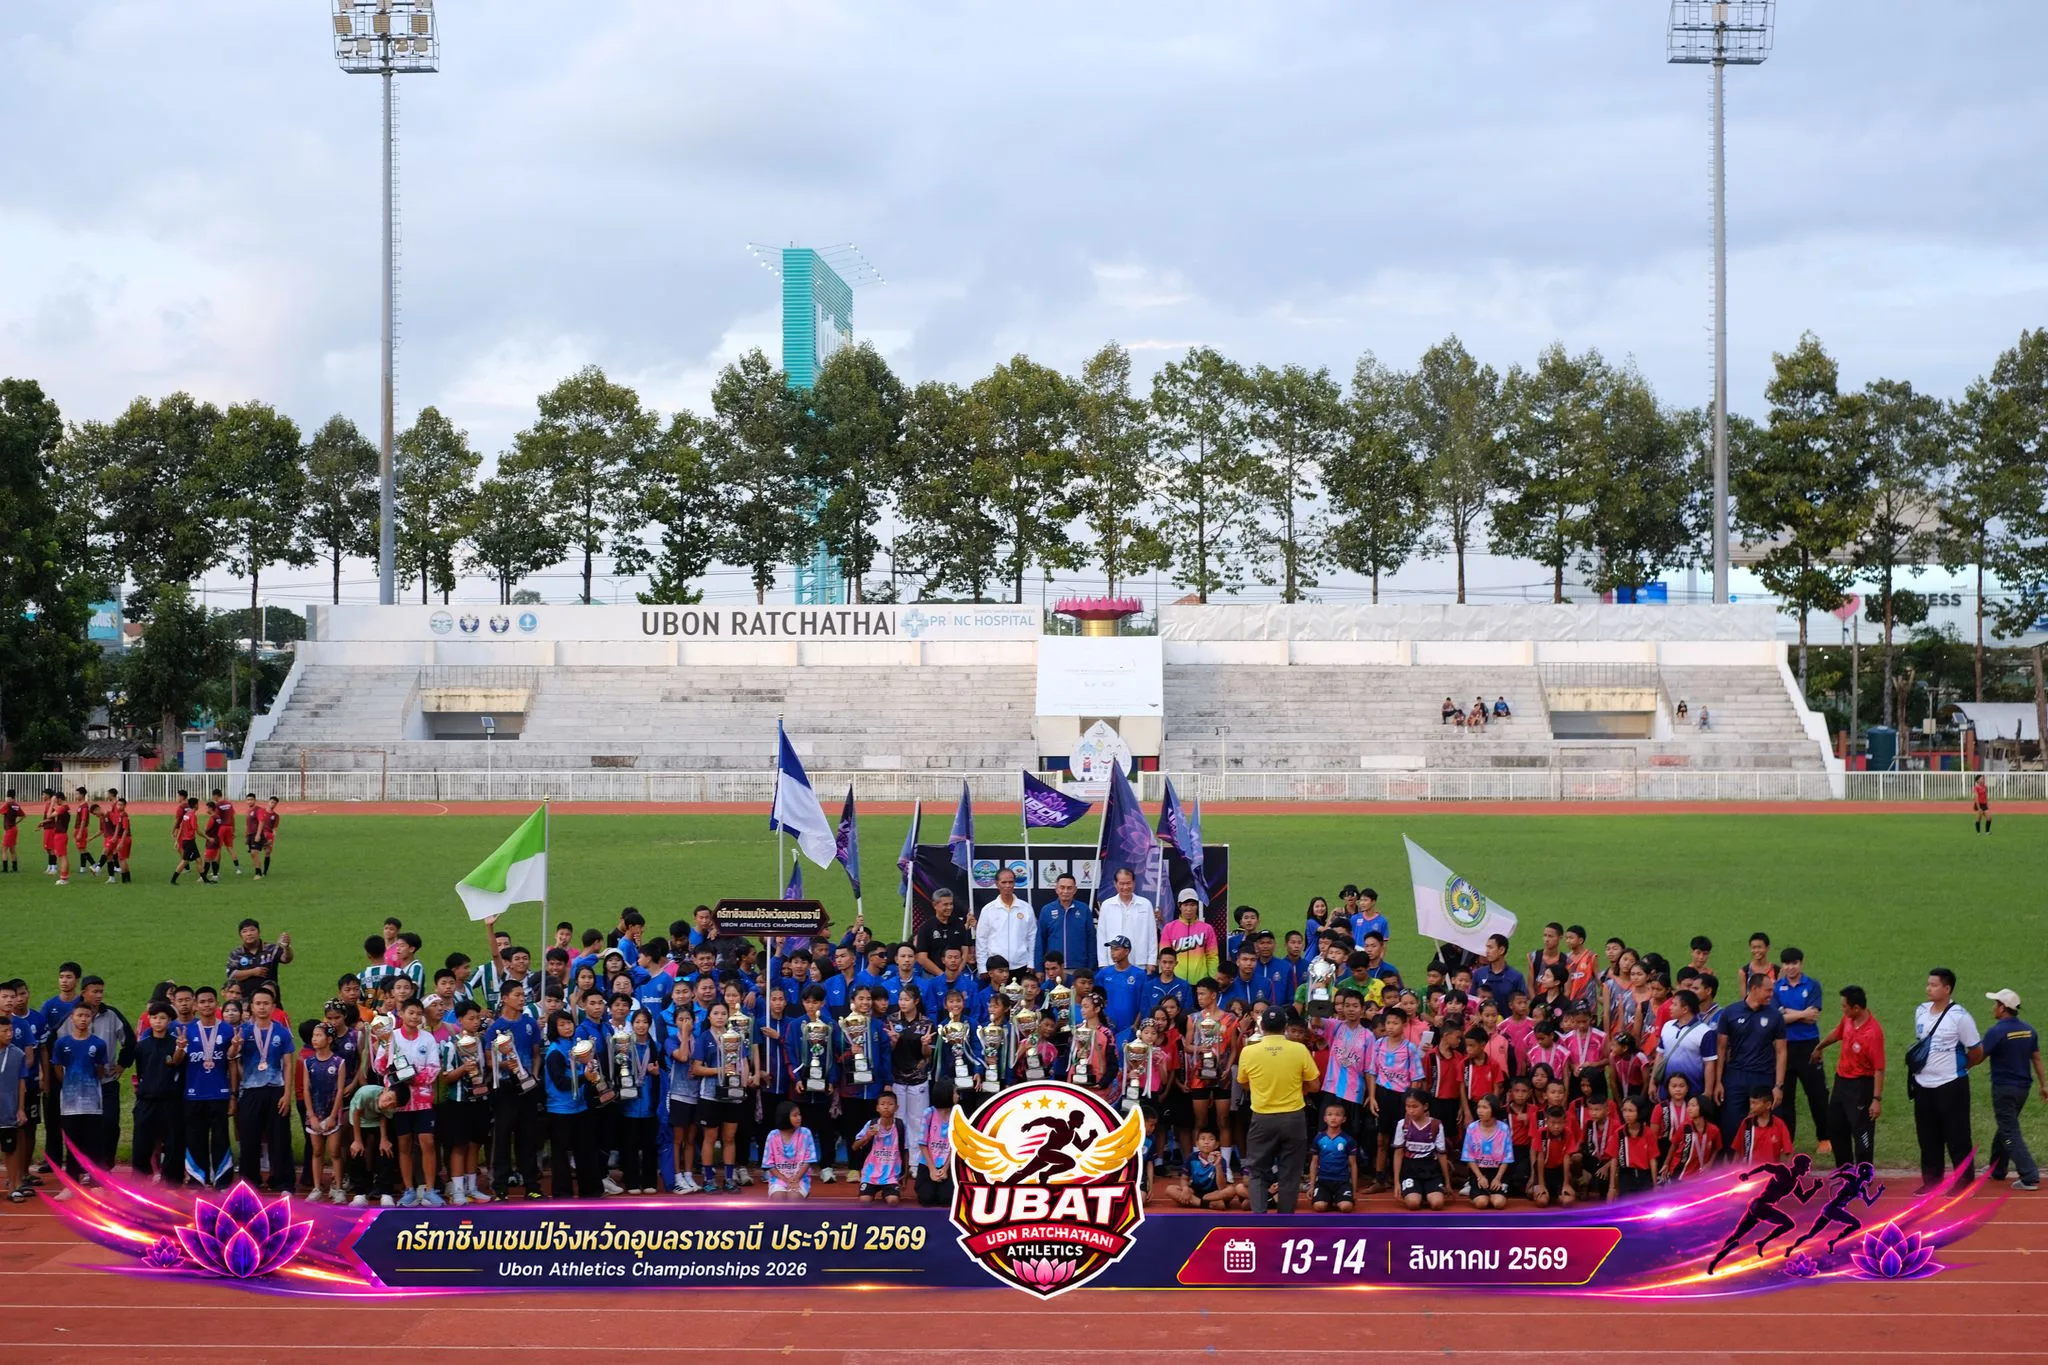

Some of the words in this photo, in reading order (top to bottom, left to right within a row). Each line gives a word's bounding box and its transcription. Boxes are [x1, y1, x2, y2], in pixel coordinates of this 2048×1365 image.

[641, 611, 720, 636] UBON
[974, 615, 1035, 627] HOSPITAL
[1172, 932, 1205, 952] UBN
